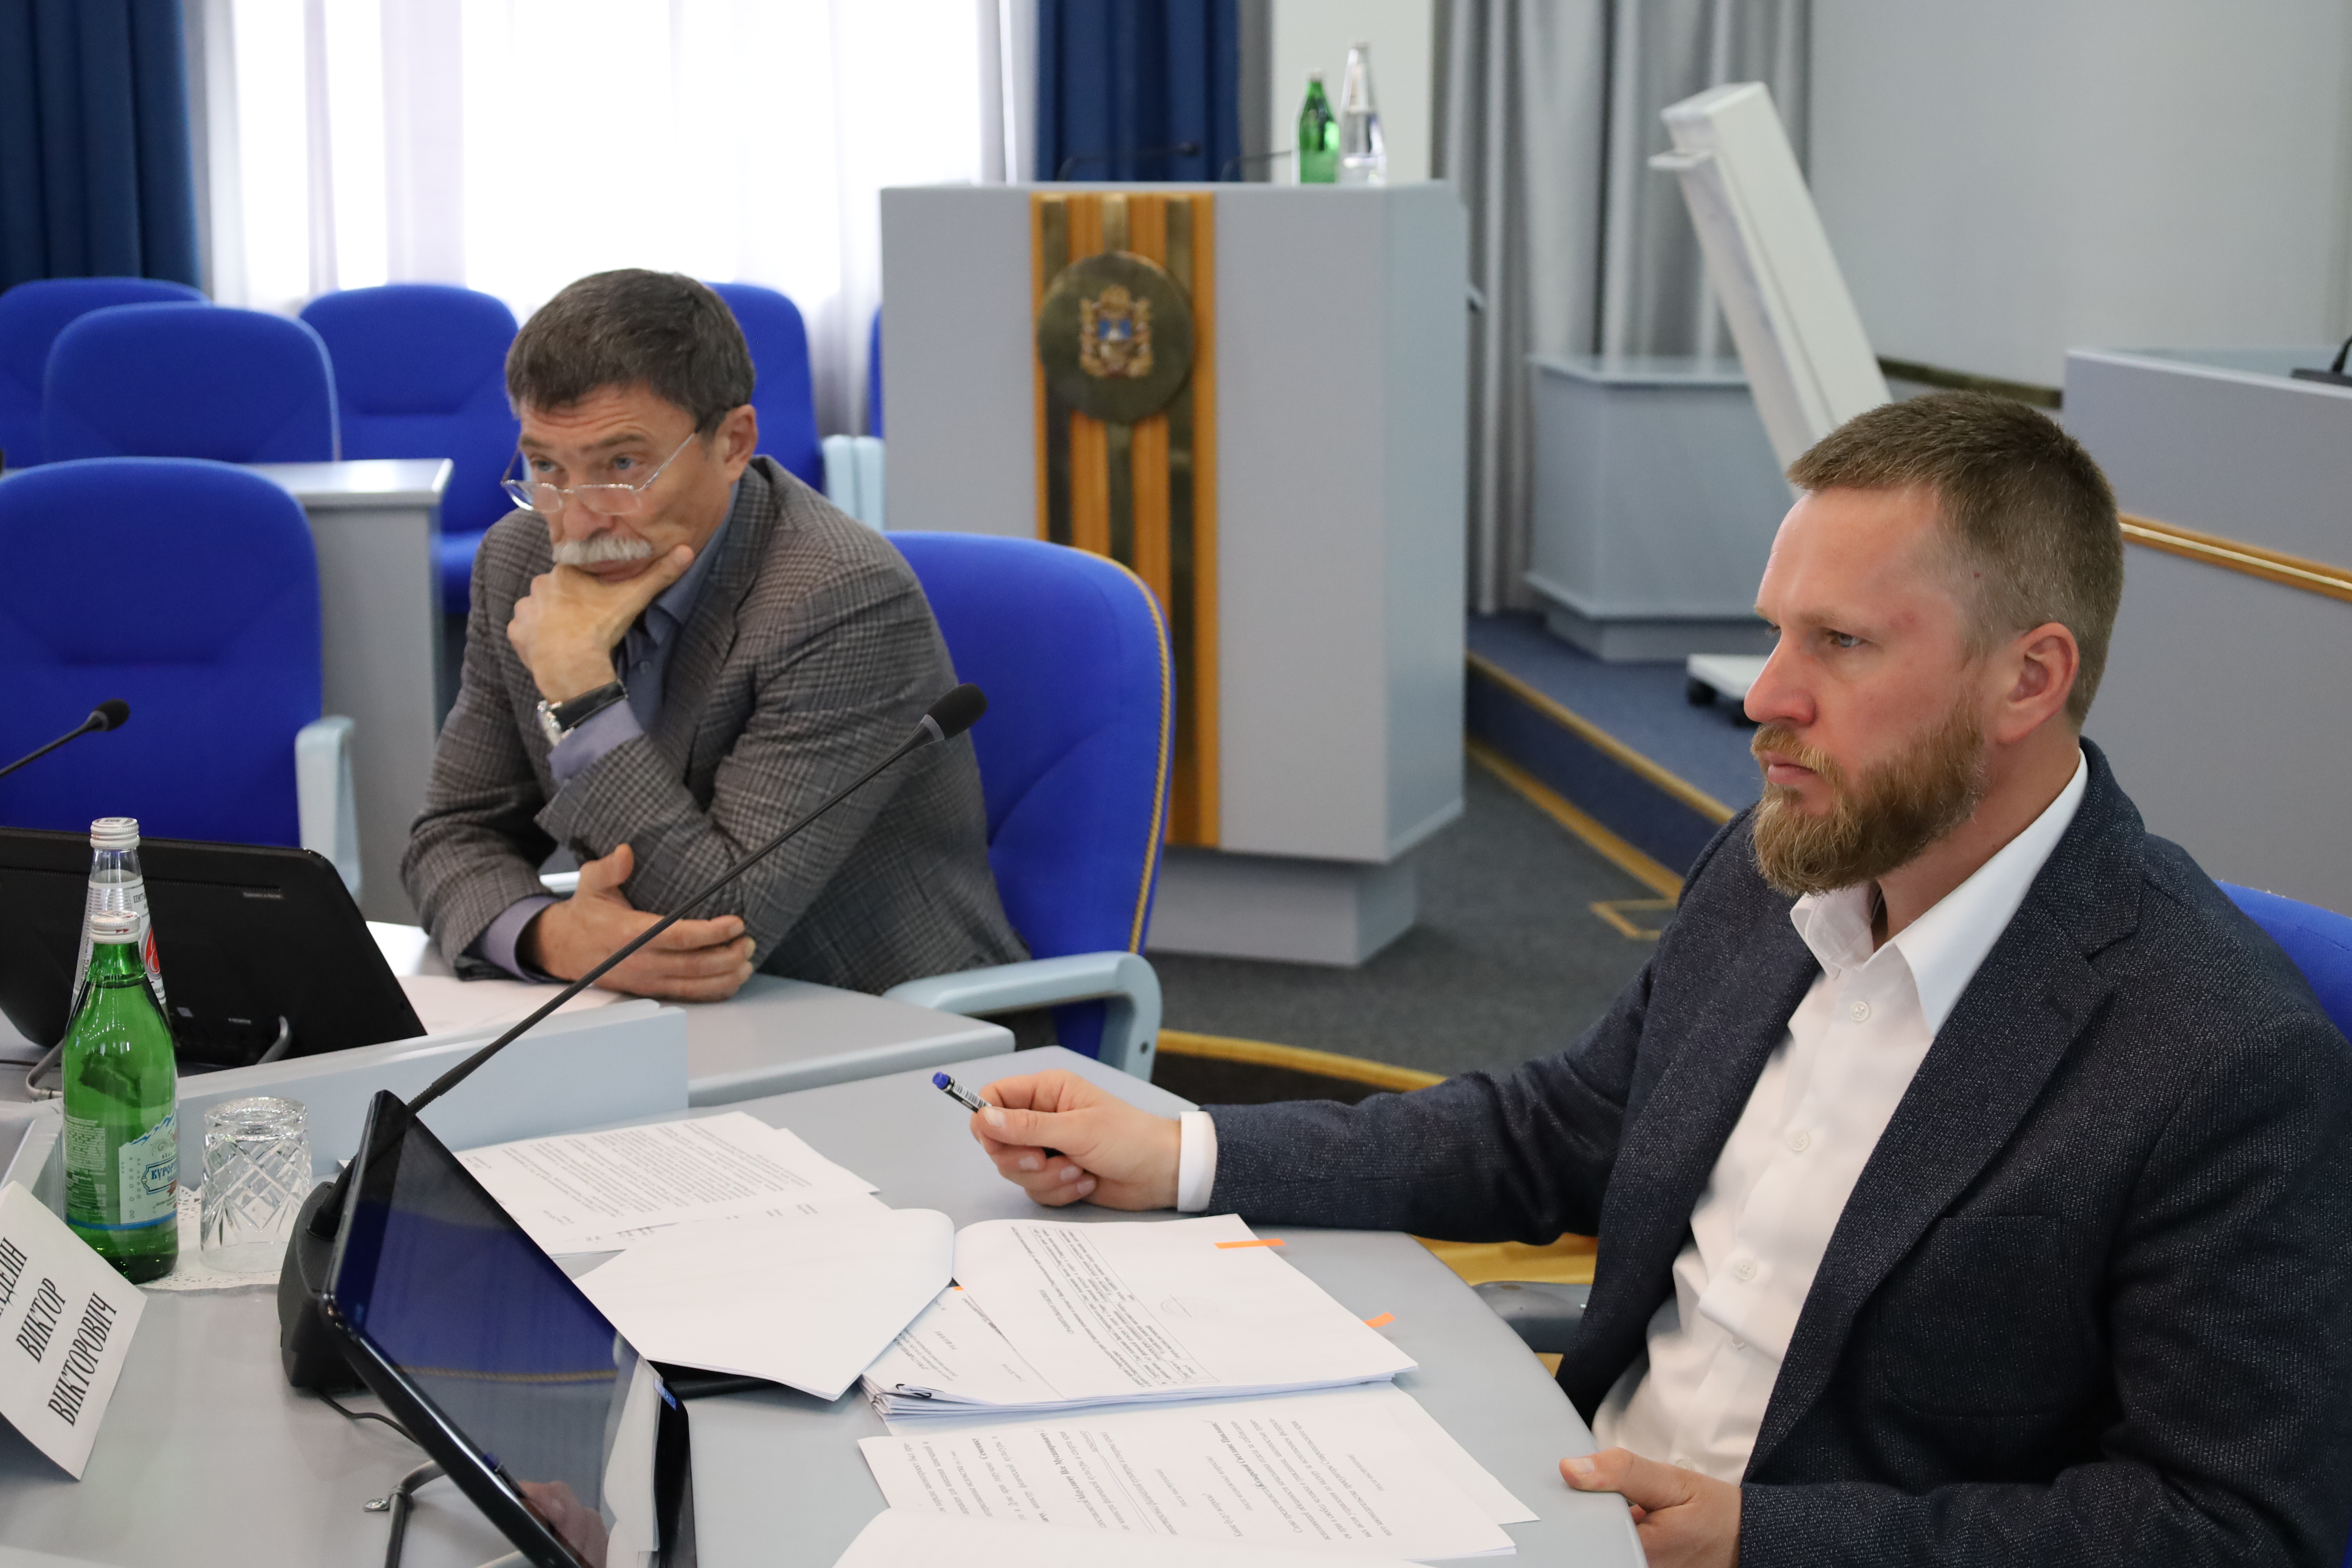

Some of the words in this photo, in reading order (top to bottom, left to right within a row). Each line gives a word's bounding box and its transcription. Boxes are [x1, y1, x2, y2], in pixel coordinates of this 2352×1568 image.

[0, 1236, 28, 1317] ДЕИН
[16, 1277, 66, 1363] ВИКТОР
[47, 1291, 117, 1427] ВИКТОРОВИЧ
[1058, 1431, 1071, 1441] края
[1258, 1431, 1283, 1458] законностью
[907, 1452, 917, 1462] был
[922, 1445, 942, 1468] замечаний
[971, 1438, 988, 1459] Семеняку
[994, 1441, 1012, 1462] культуры
[1065, 1440, 1079, 1456] спорта
[1107, 1443, 1124, 1460] спорта
[1226, 1443, 1246, 1464] Светлане
[1251, 1449, 1267, 1463] отдела
[1283, 1437, 1309, 1464] исполнением
[1297, 1430, 1330, 1465] Ставропольского
[912, 1462, 933, 1490] законопроект
[936, 1468, 953, 1487] внесения
[956, 1465, 974, 1487] ведомства
[985, 1461, 1002, 1482] поручено
[1004, 1464, 1029, 1488] физической
[1076, 1460, 1096, 1480] культуры
[1262, 1463, 1286, 1486] начальника
[1310, 1470, 1328, 1485] надзору
[997, 1484, 1009, 1494] края
[1088, 1480, 1114, 1504] физической
[1281, 1486, 1307, 1511] обязанности
[1302, 1485, 1321, 1504] человека
[952, 1496, 970, 1515] аправлен
[1005, 1496, 1019, 1507] Думе
[1023, 1490, 1041, 1509] министру
[1174, 1494, 1190, 1507] (после
[1201, 1493, 1224, 1512] вопросы?
[1328, 1491, 1356, 1516] управления
[1348, 1490, 1384, 1526] законодательства
[1107, 1504, 1126, 1524] министра
[1218, 1512, 1234, 1524] будут
[1317, 1504, 1335, 1519] свобод
[1228, 1524, 1244, 1537] Какие
[1287, 1519, 1303, 1533] Слово
[1300, 1511, 1332, 1540] исполняющей
[1333, 1522, 1348, 1533] прав
[1349, 1516, 1365, 1528] актов
[1360, 1529, 1373, 1537] вых
